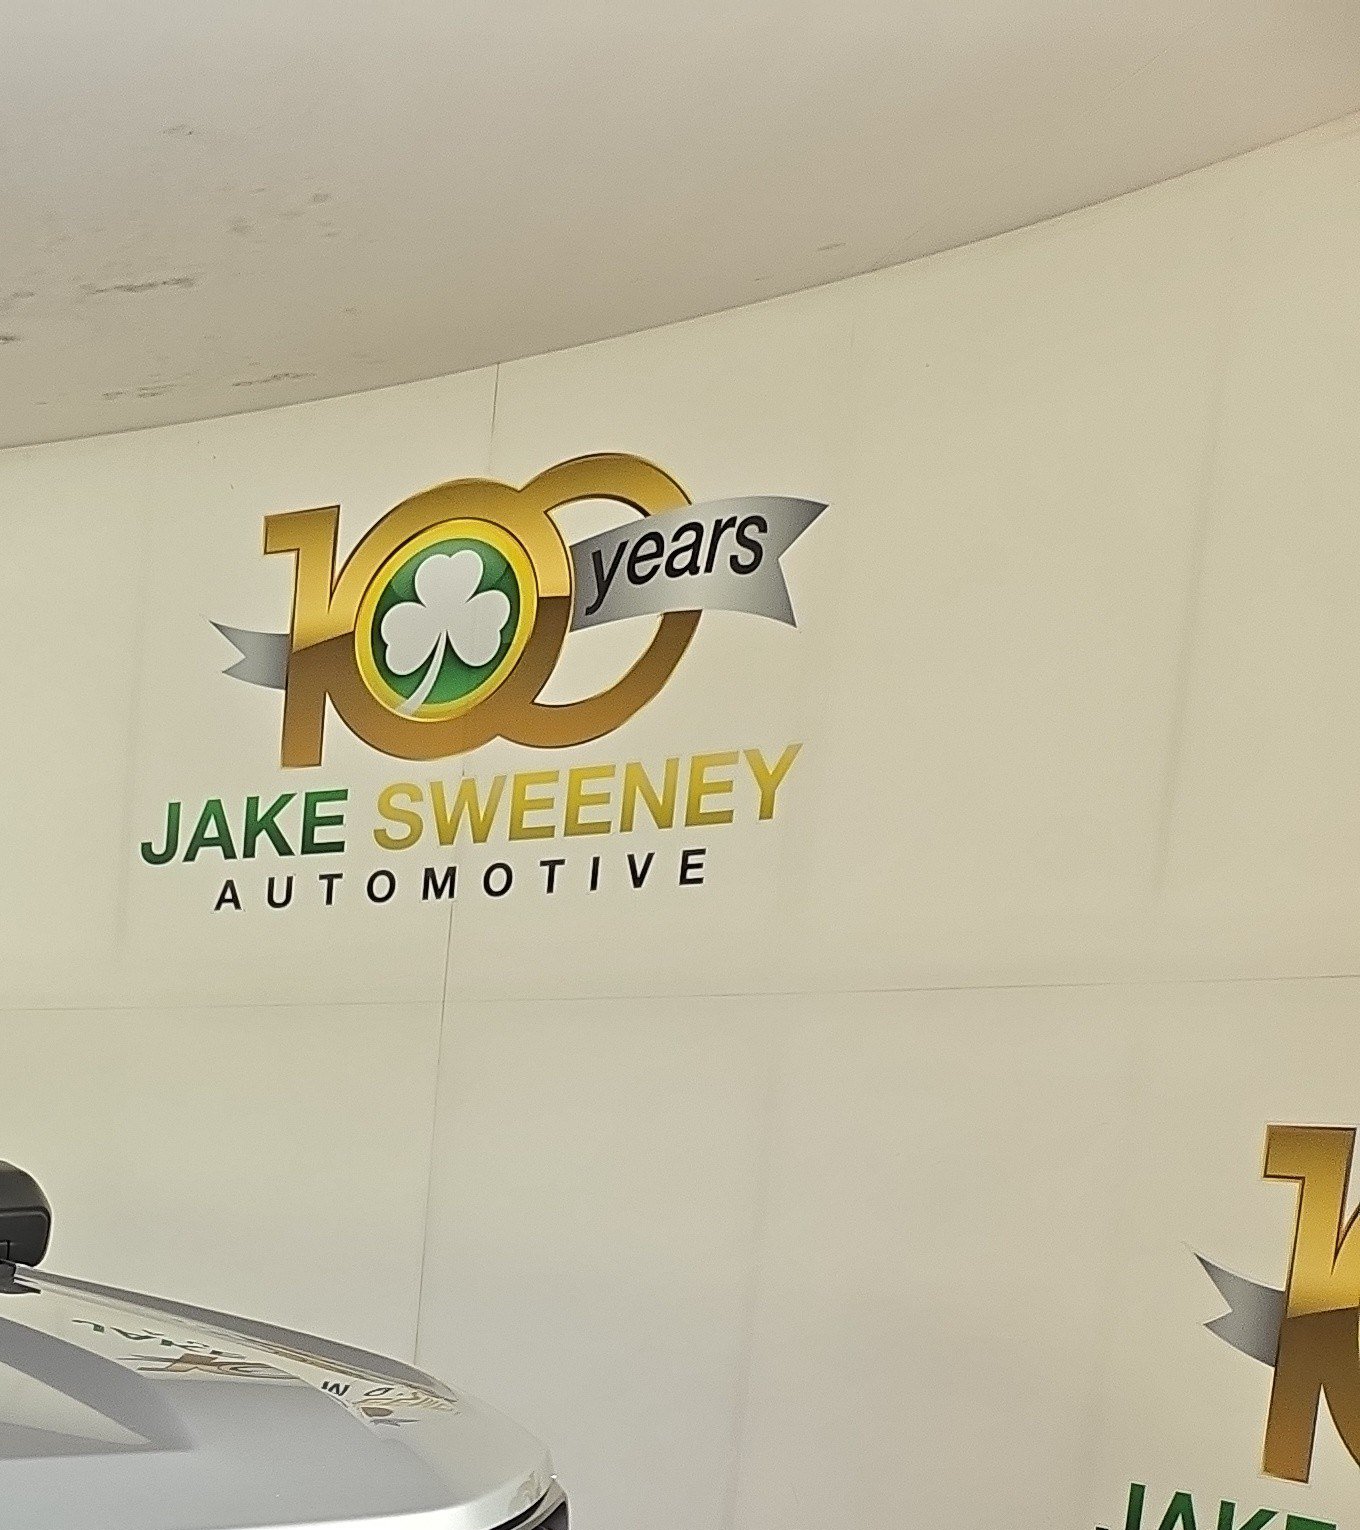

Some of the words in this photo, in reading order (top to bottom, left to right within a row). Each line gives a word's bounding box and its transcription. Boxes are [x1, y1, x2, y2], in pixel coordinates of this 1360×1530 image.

[262, 453, 703, 768] 100
[584, 509, 769, 614] years
[139, 788, 349, 866] JAKE
[371, 743, 804, 851] SWEENEY
[213, 848, 709, 912] AUTOMOTIVE
